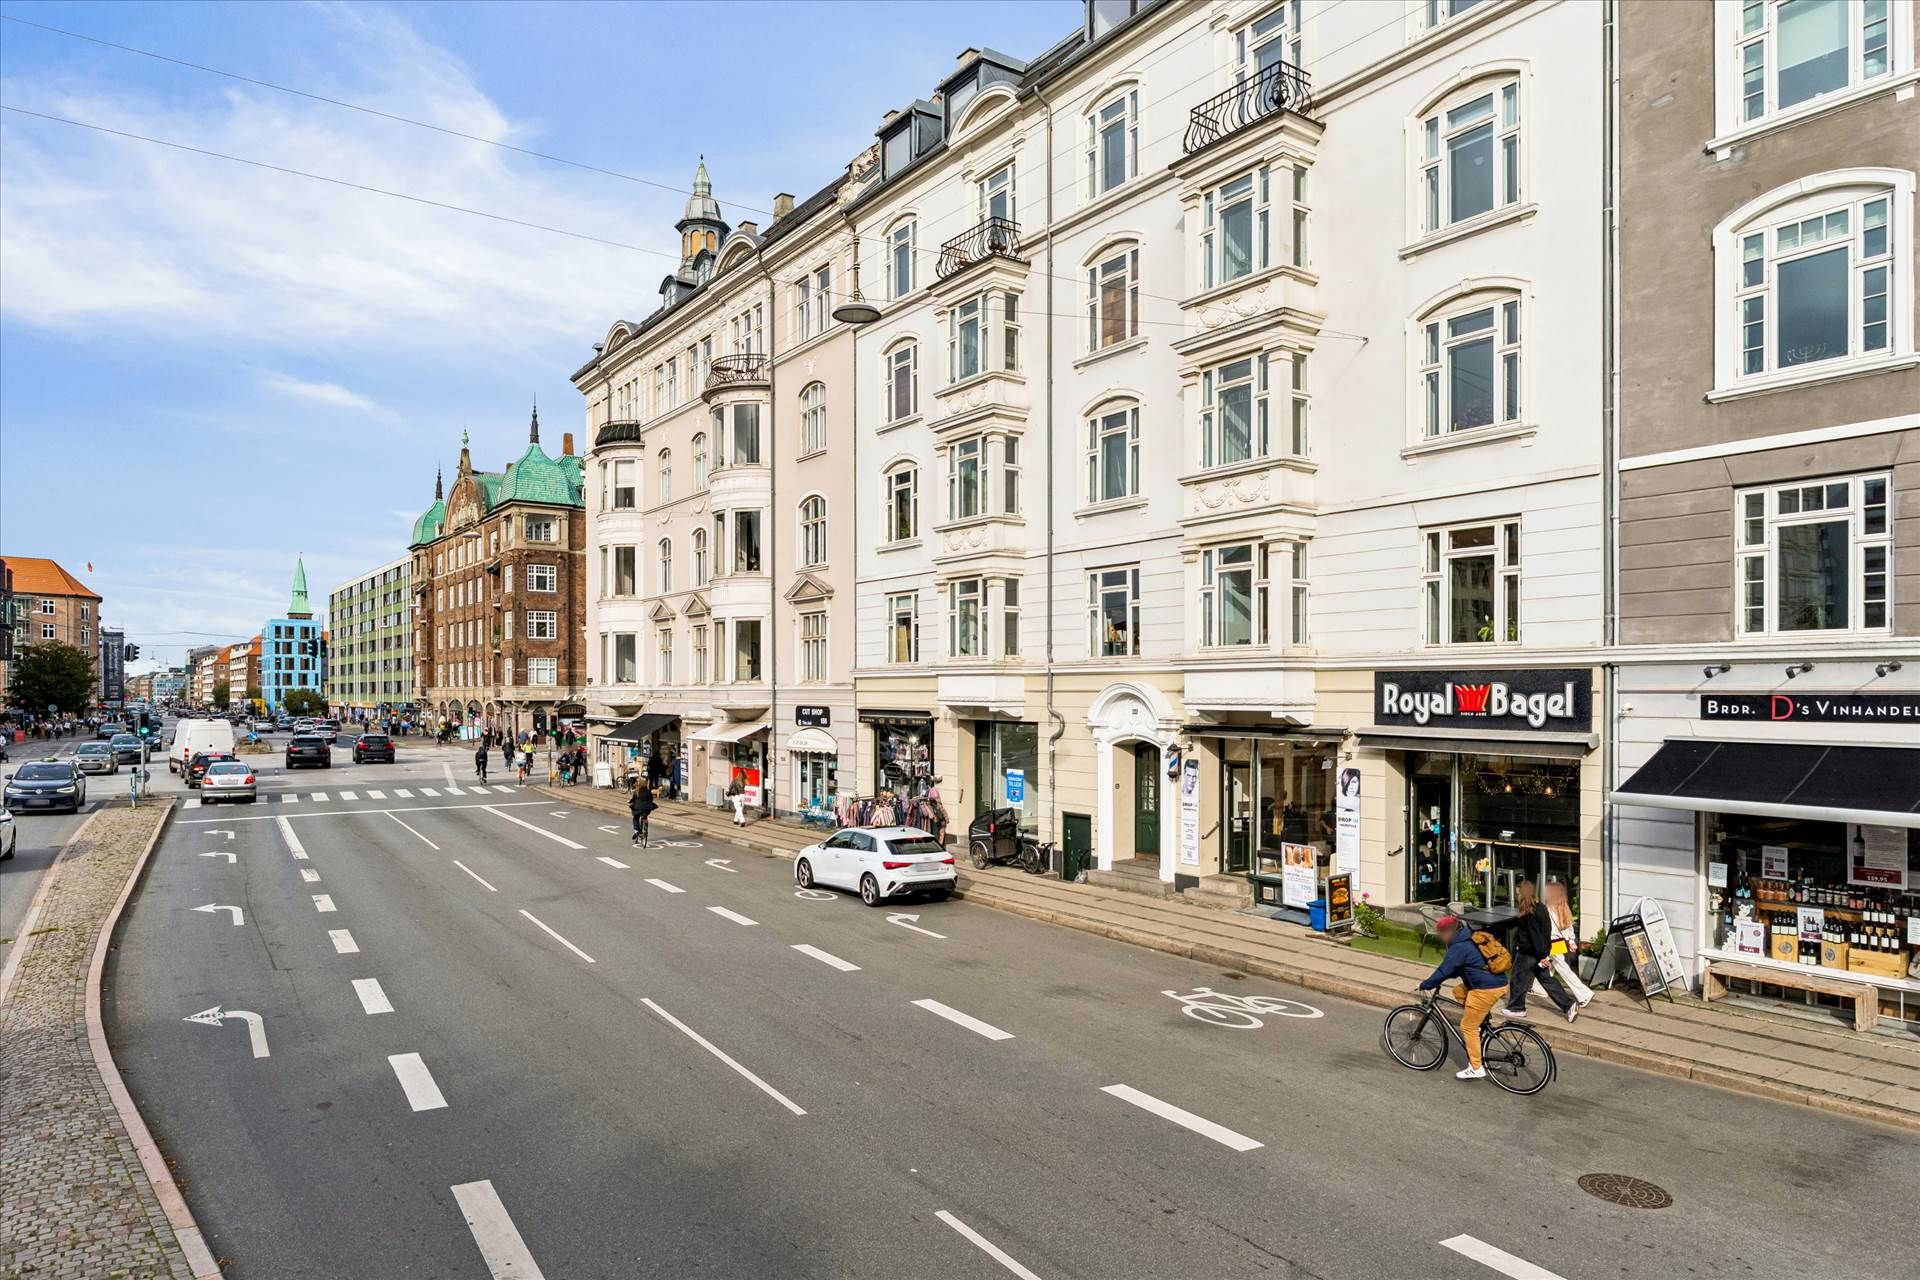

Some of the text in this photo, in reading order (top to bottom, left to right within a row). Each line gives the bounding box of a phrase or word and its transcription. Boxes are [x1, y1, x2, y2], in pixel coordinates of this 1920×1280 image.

[802, 708, 824, 716] CUT SHOP
[1382, 682, 1575, 728] Royal Bagel
